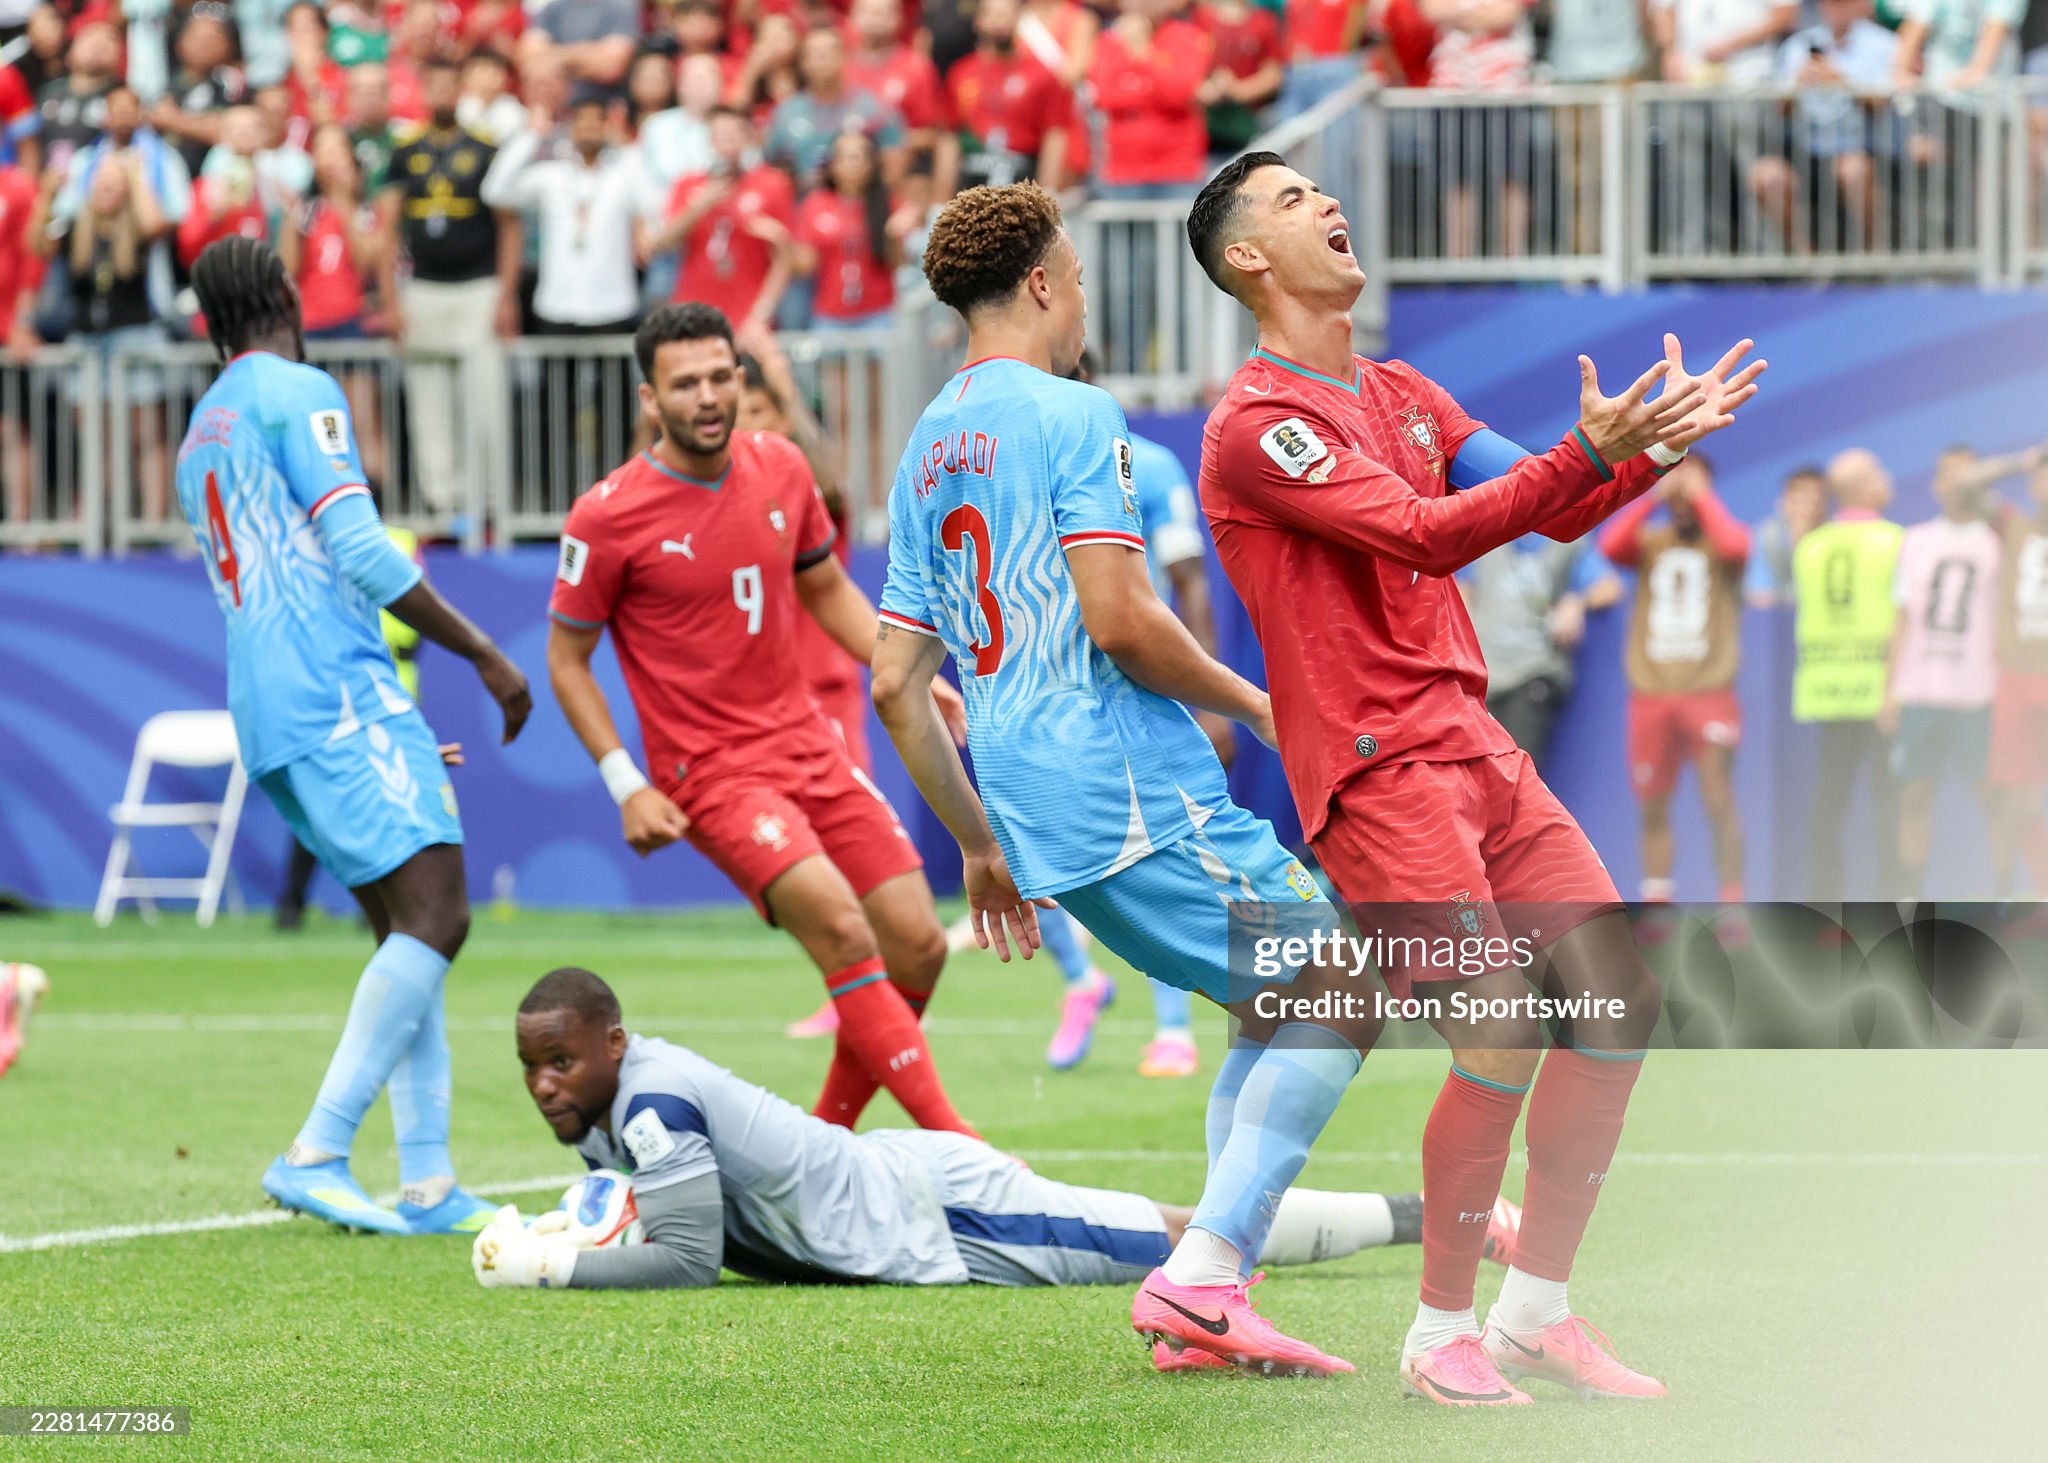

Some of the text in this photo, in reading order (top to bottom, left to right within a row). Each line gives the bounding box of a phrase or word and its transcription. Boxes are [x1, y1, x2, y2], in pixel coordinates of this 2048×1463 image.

[912, 430, 998, 509] KAPUADI
[205, 470, 242, 608] 4
[940, 503, 1005, 677] 3
[731, 563, 765, 636] 9
